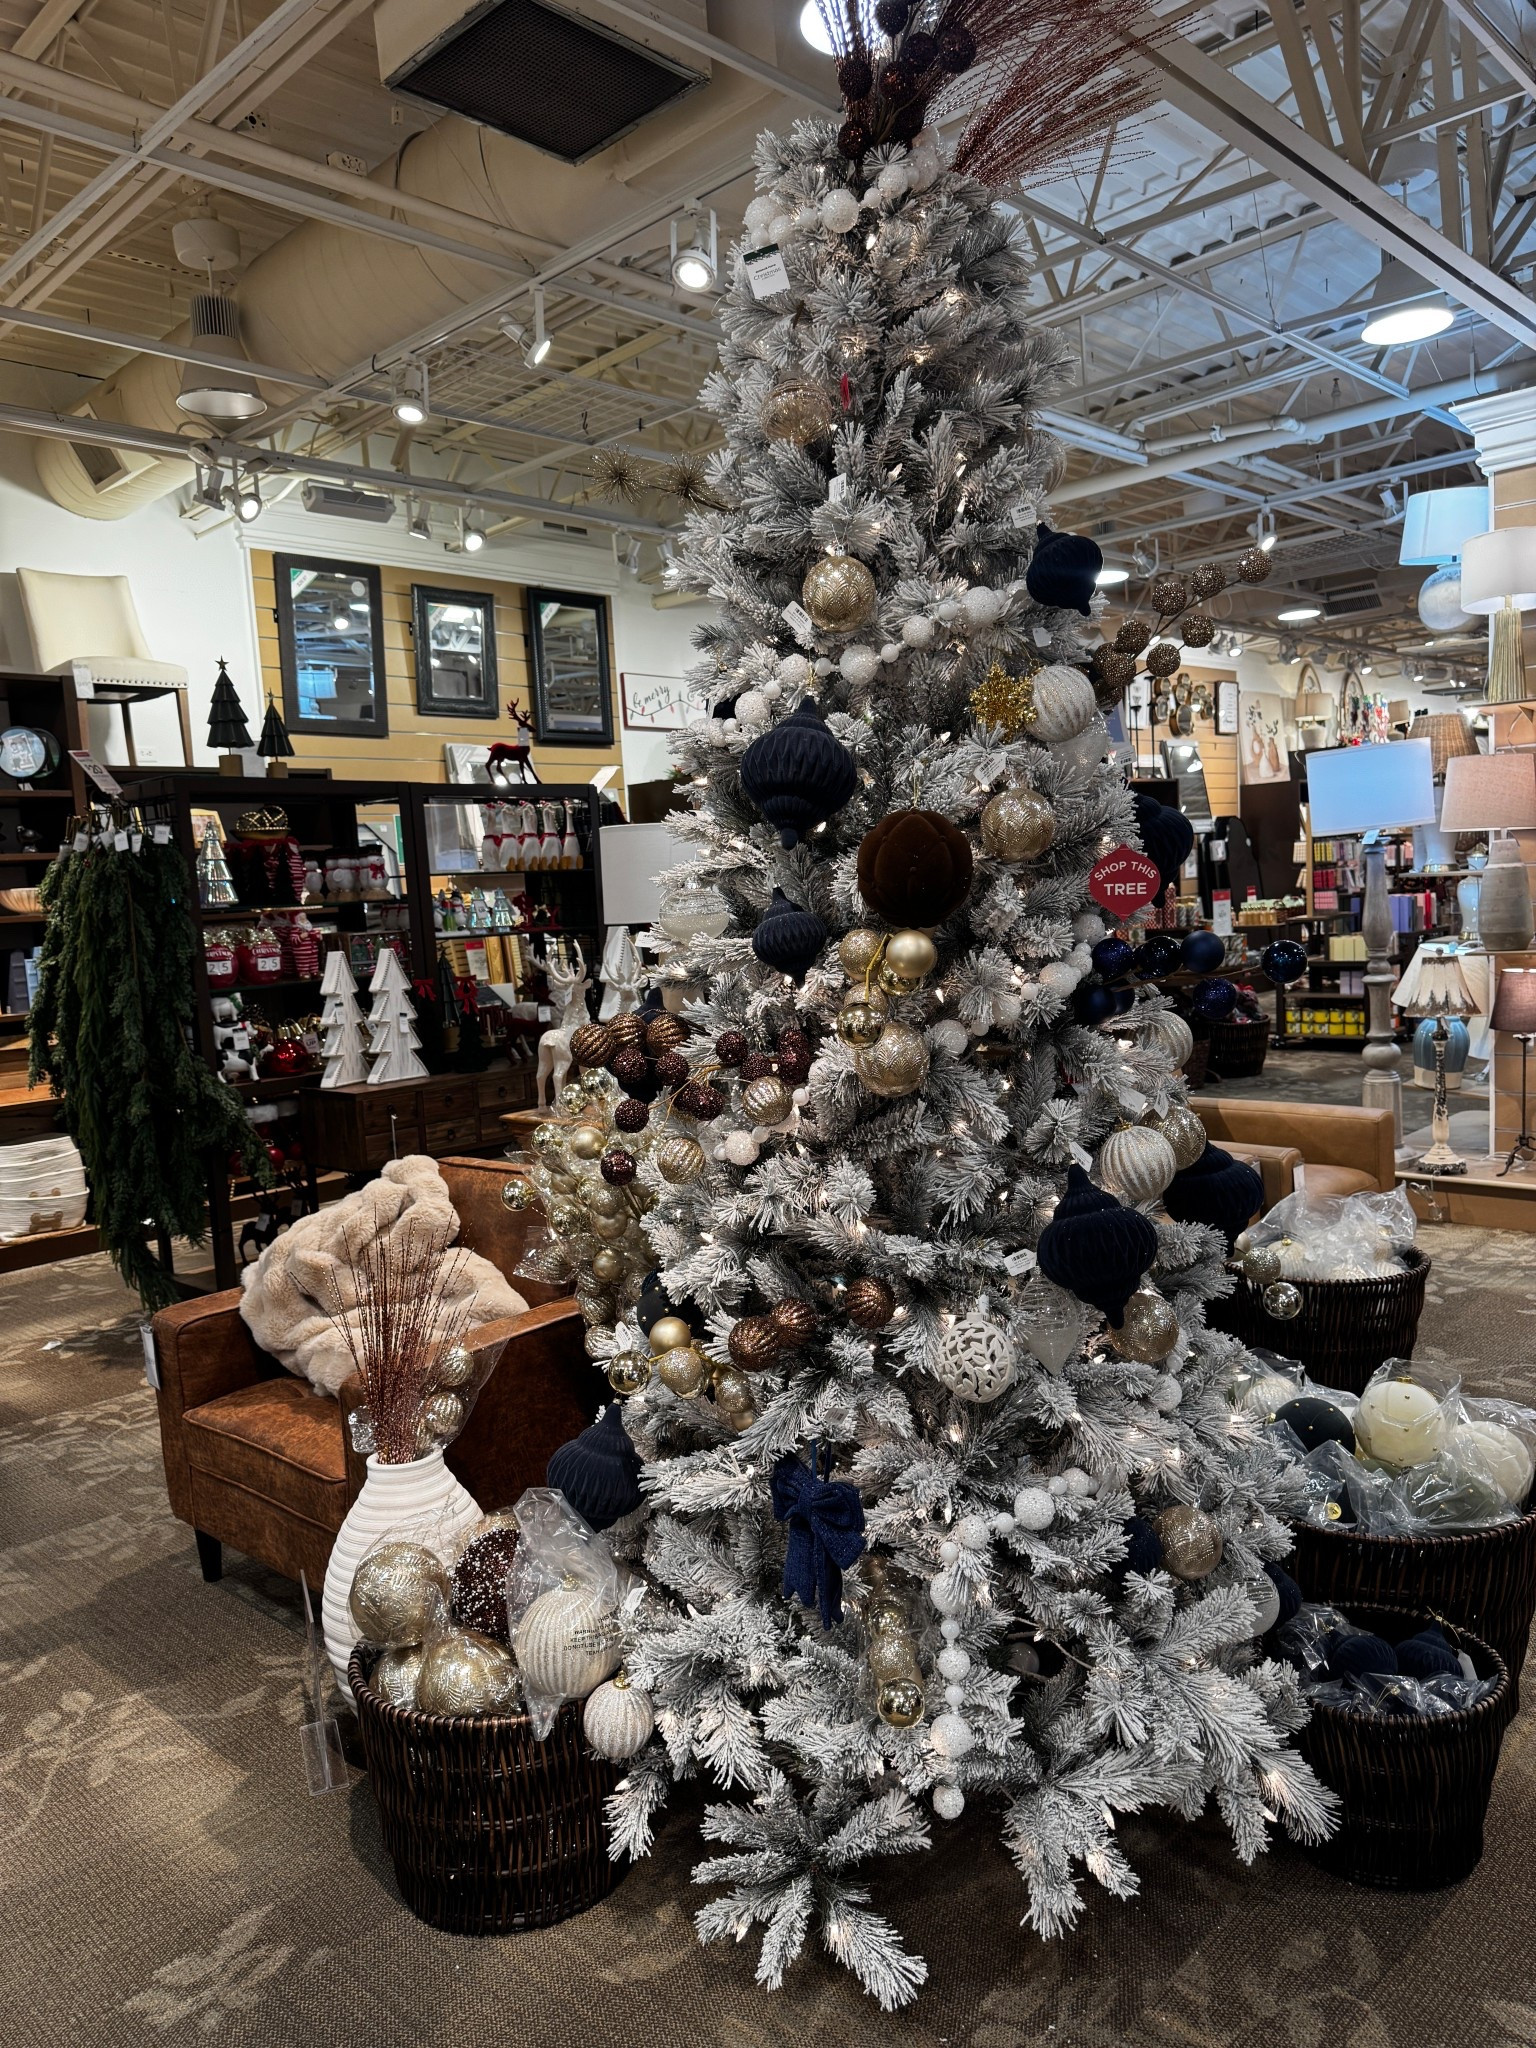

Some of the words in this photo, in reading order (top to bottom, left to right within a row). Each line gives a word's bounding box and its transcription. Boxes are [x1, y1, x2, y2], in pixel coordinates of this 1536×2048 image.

[1094, 861, 1127, 881] SHOP
[1130, 861, 1157, 879] THIS
[1103, 882, 1147, 896] TREE
